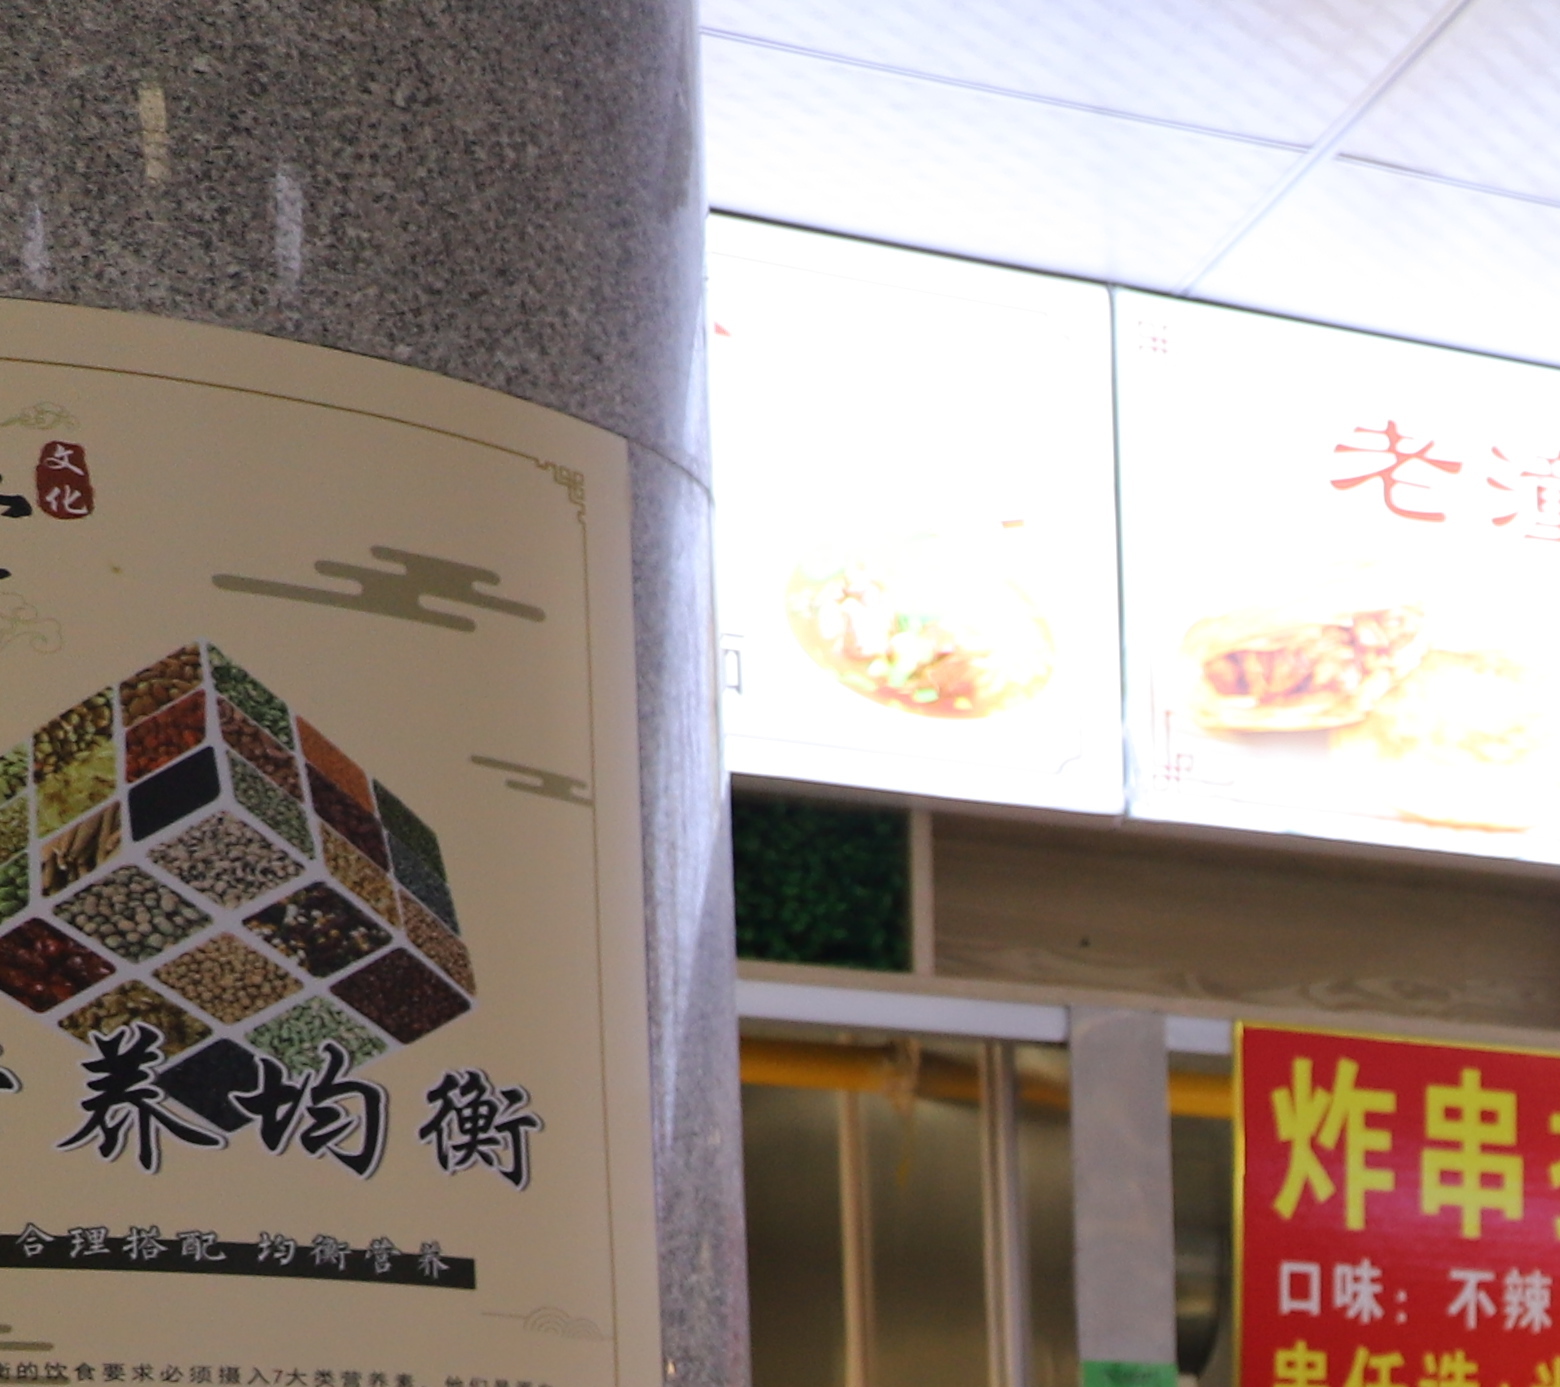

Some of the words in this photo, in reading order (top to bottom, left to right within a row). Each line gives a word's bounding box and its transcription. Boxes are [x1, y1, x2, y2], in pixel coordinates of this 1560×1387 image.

[44, 443, 90, 518] 文化
[0, 1025, 541, 1188] 养均衡
[16, 1223, 227, 1263] 合理搭配
[258, 1231, 450, 1281] 均衡营养
[1447, 1267, 1552, 1334] 不辣
